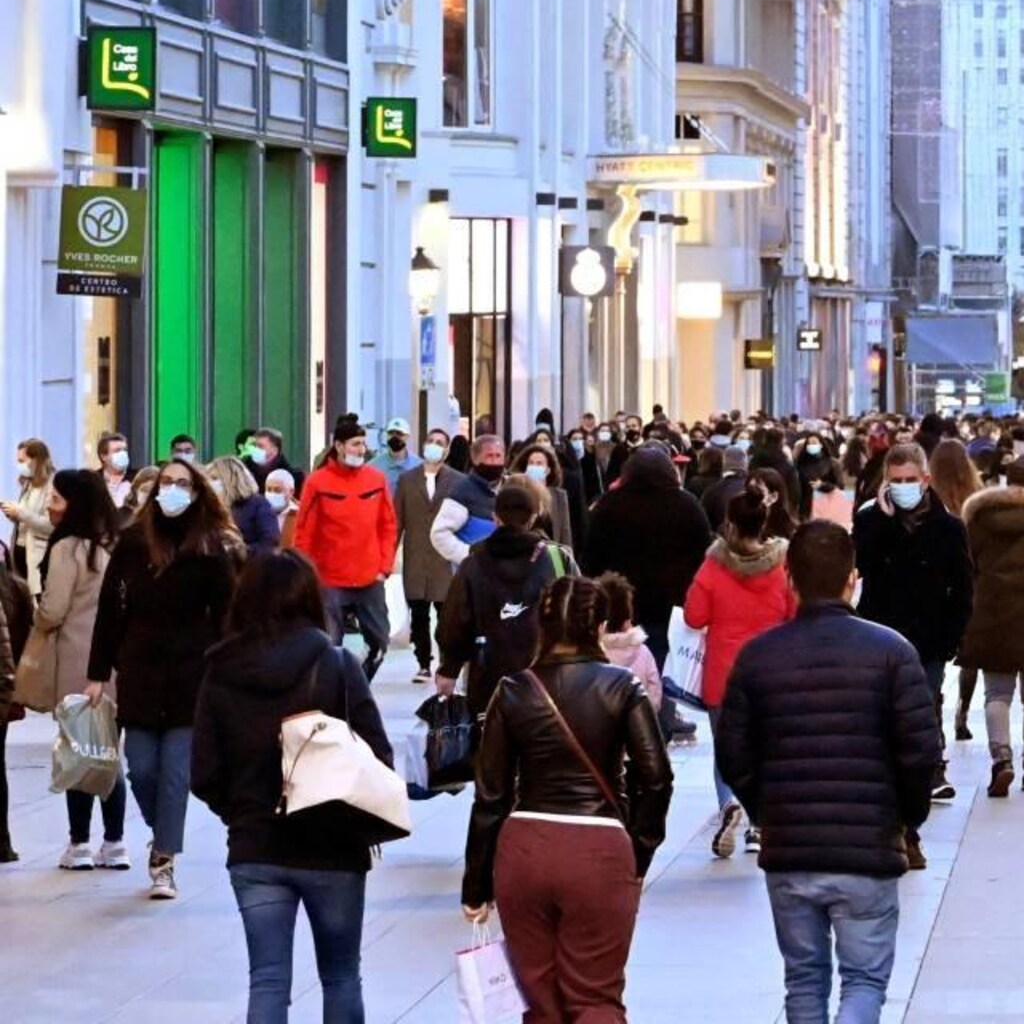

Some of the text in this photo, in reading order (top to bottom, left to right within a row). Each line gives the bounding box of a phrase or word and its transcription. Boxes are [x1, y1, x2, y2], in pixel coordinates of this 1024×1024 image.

[596, 161, 634, 173] HYATT
[65, 252, 138, 264] YVES ROCHER
[81, 277, 118, 286] CENTRO
